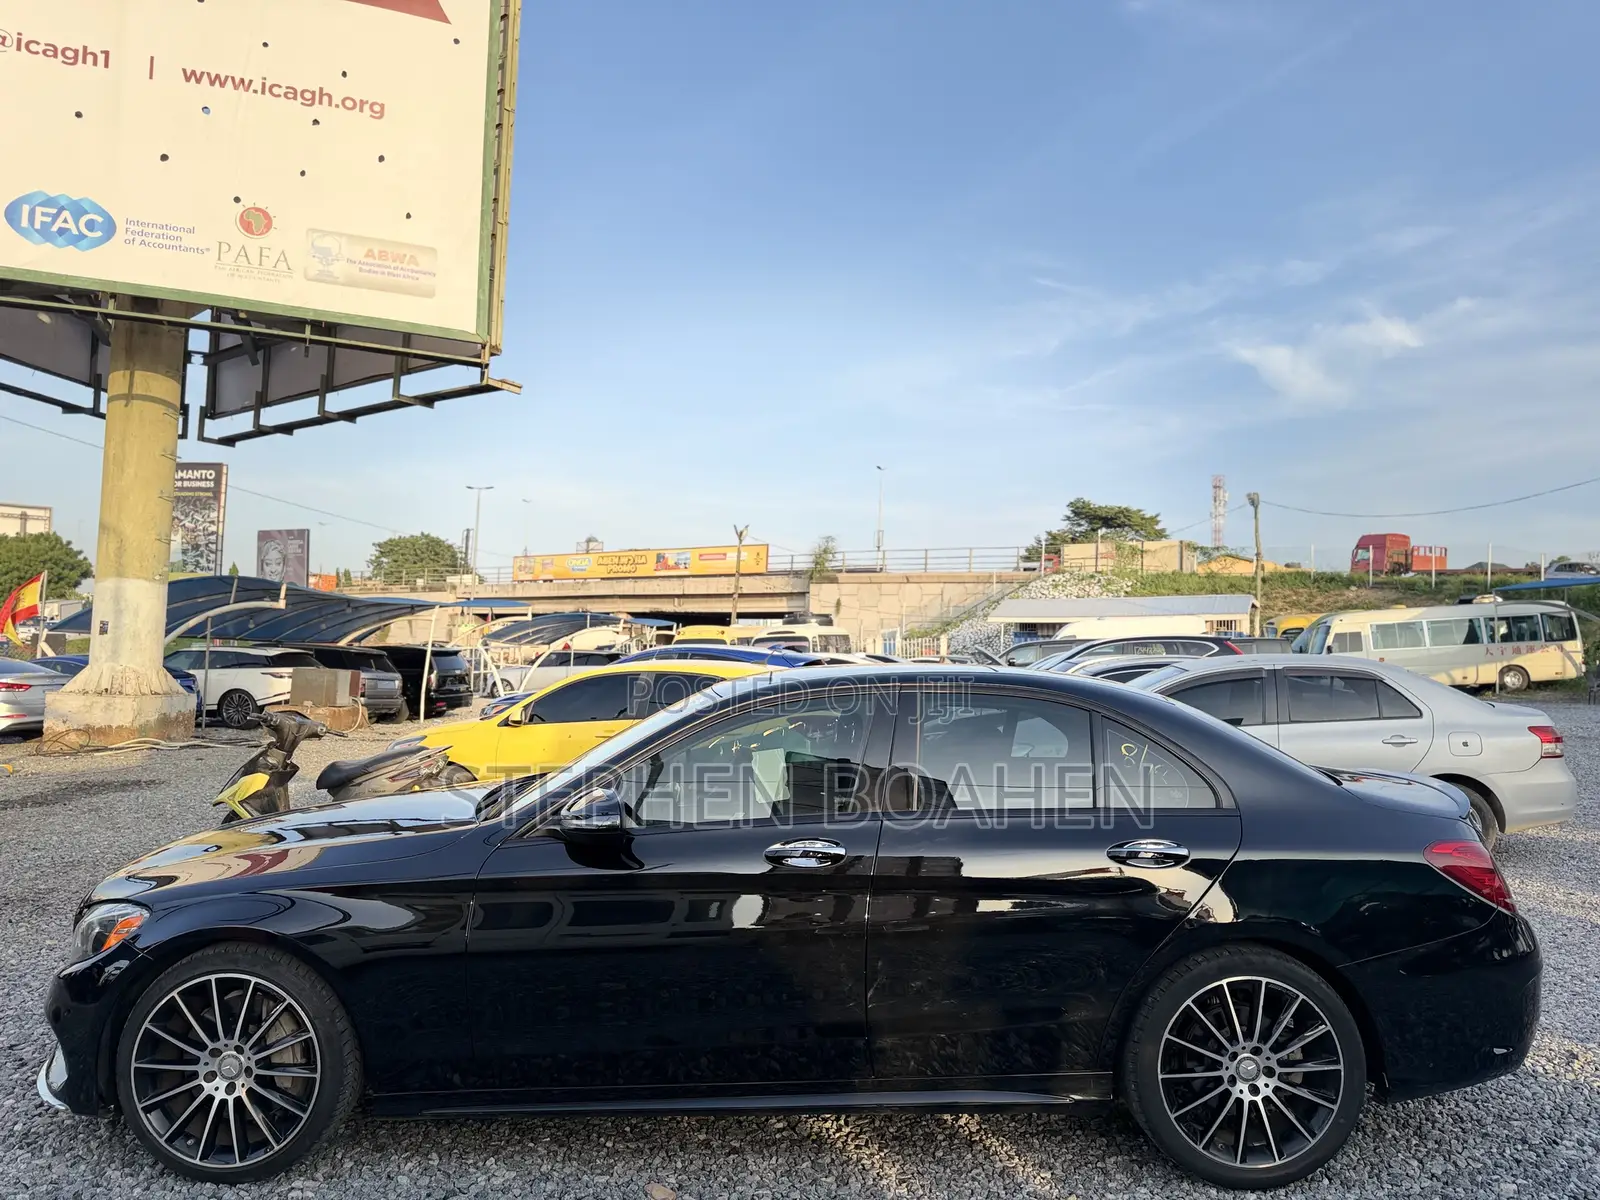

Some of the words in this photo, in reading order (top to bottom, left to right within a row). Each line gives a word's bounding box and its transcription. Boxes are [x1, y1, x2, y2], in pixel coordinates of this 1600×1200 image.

[181, 67, 386, 120] www.icagh.org
[20, 203, 104, 238] IFAC
[125, 217, 196, 235] International
[124, 237, 137, 246] of
[125, 227, 183, 243] Federation
[216, 240, 293, 271] PAFA
[363, 247, 420, 268] ABWA
[183, 480, 215, 488] BUSINESS
[607, 564, 638, 574] PROMO
